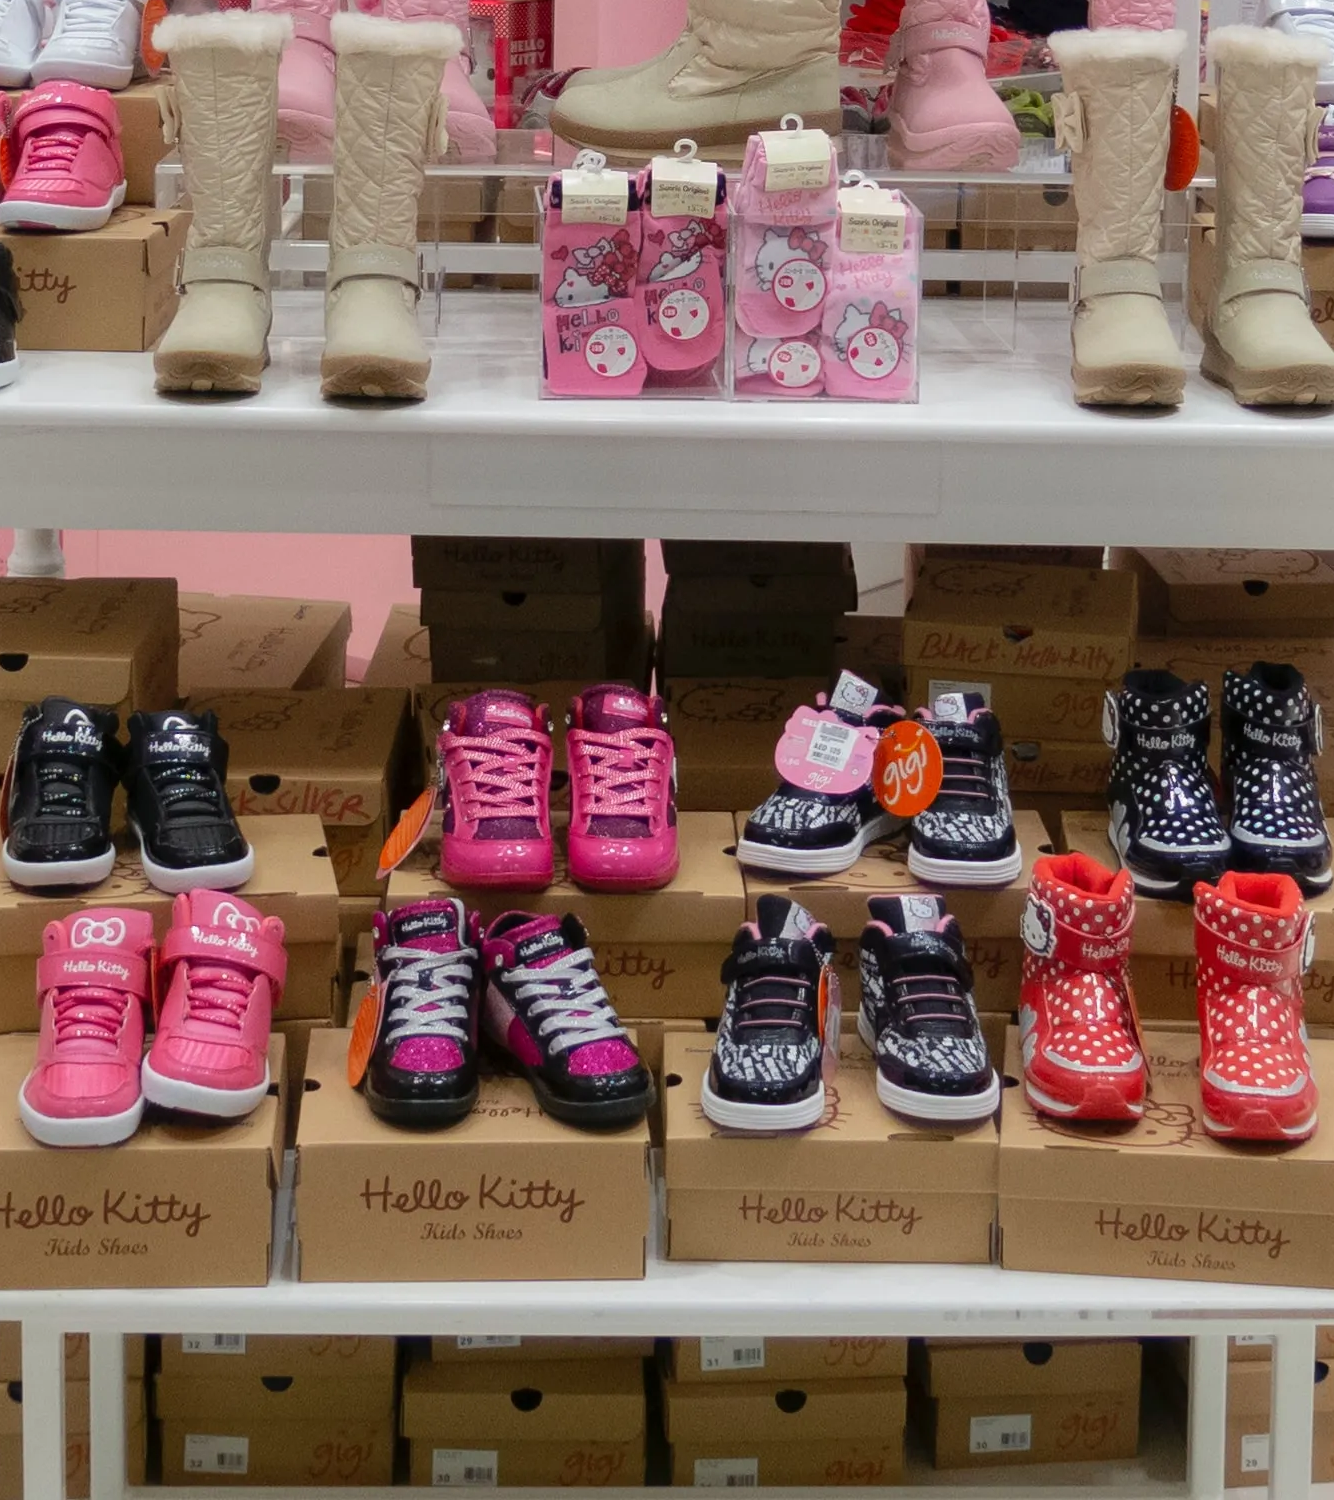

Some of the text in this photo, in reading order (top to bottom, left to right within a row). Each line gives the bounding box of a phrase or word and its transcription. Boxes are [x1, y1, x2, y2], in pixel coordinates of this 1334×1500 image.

[510, 38, 546, 51] HELLO
[510, 51, 546, 66] KITTY
[848, 217, 899, 229] Sanrio Original
[16, 267, 77, 304] itty
[443, 544, 565, 571] Hello Kitty
[42, 730, 103, 751] Hello Kitty
[929, 726, 954, 738] Hello
[1137, 733, 1196, 750] Hello Kitty
[1243, 723, 1302, 748] Hello Kitty
[149, 740, 180, 754] Hello
[813, 741, 828, 751] AED
[883, 728, 928, 806] gigi
[803, 769, 836, 790] gigi
[193, 931, 259, 956] Hello Kitty
[520, 942, 543, 956] Hello
[1081, 940, 1115, 959] Hello
[1217, 944, 1283, 974] Hello Kitty
[63, 960, 130, 980] Hello Kitty
[598, 950, 675, 991] itty
[361, 1174, 585, 1223] Hello Kitty
[103, 1189, 211, 1237] Kitty
[738, 1194, 923, 1235] Hello Kitty
[420, 1222, 523, 1241] Kids Shoes
[787, 1232, 872, 1248] Kids Shoes
[1095, 1207, 1291, 1260] Hello Kitty
[44, 1237, 149, 1257] Kids Shoes
[1146, 1249, 1236, 1271] Kids Shoes
[187, 1340, 200, 1349] 32
[706, 1358, 720, 1367] 31
[975, 1441, 988, 1450] 30
[190, 1459, 203, 1468] 32
